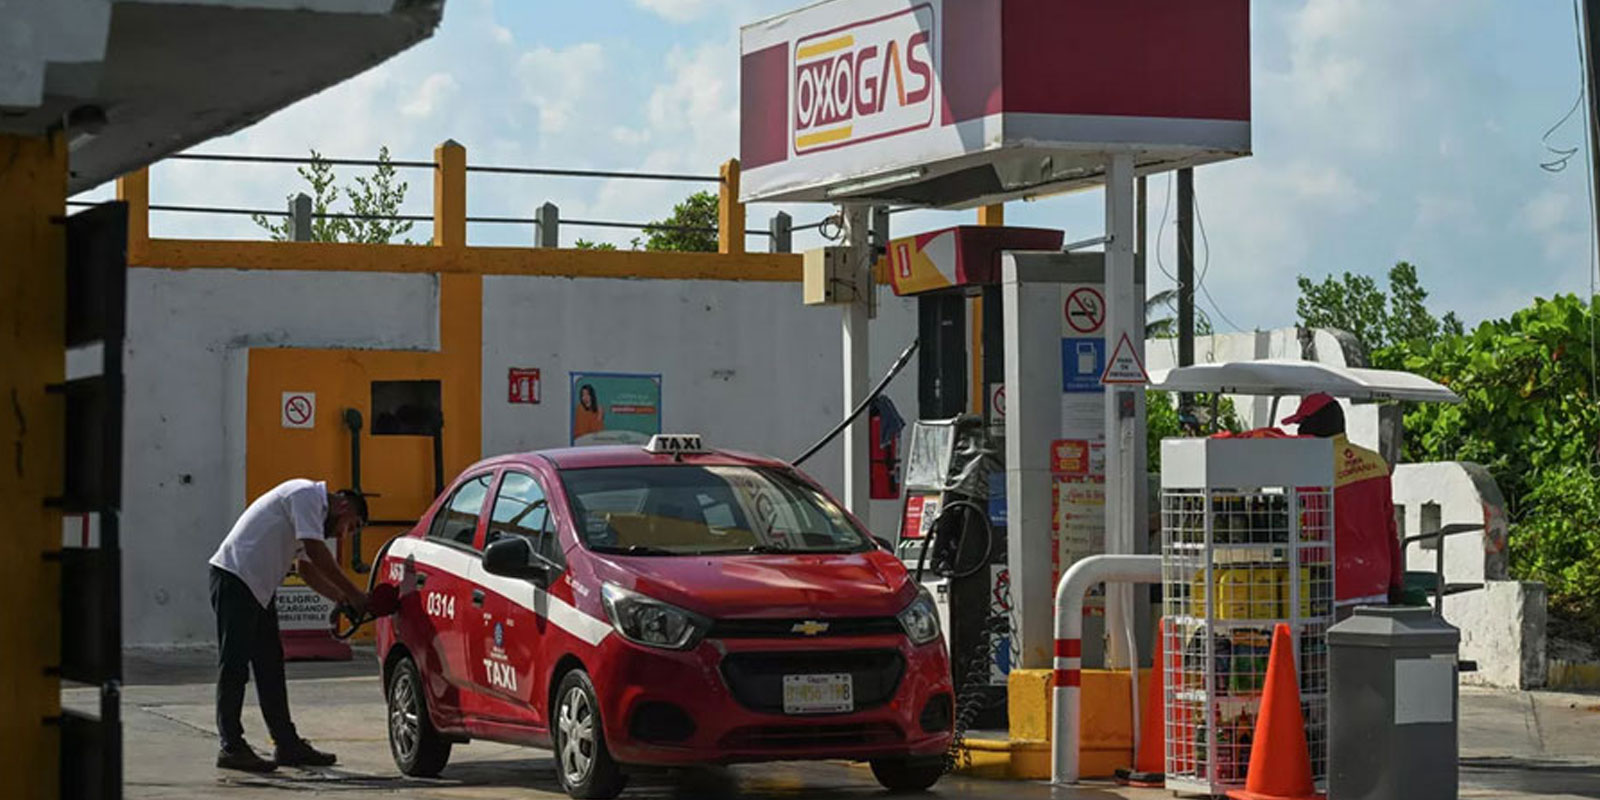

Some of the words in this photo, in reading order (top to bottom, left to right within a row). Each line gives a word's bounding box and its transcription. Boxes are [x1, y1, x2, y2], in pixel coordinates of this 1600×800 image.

[658, 437, 701, 450] TAXI
[277, 604, 328, 612] CARGANDO
[426, 591, 455, 620] 0314
[483, 658, 517, 692] TAXI
